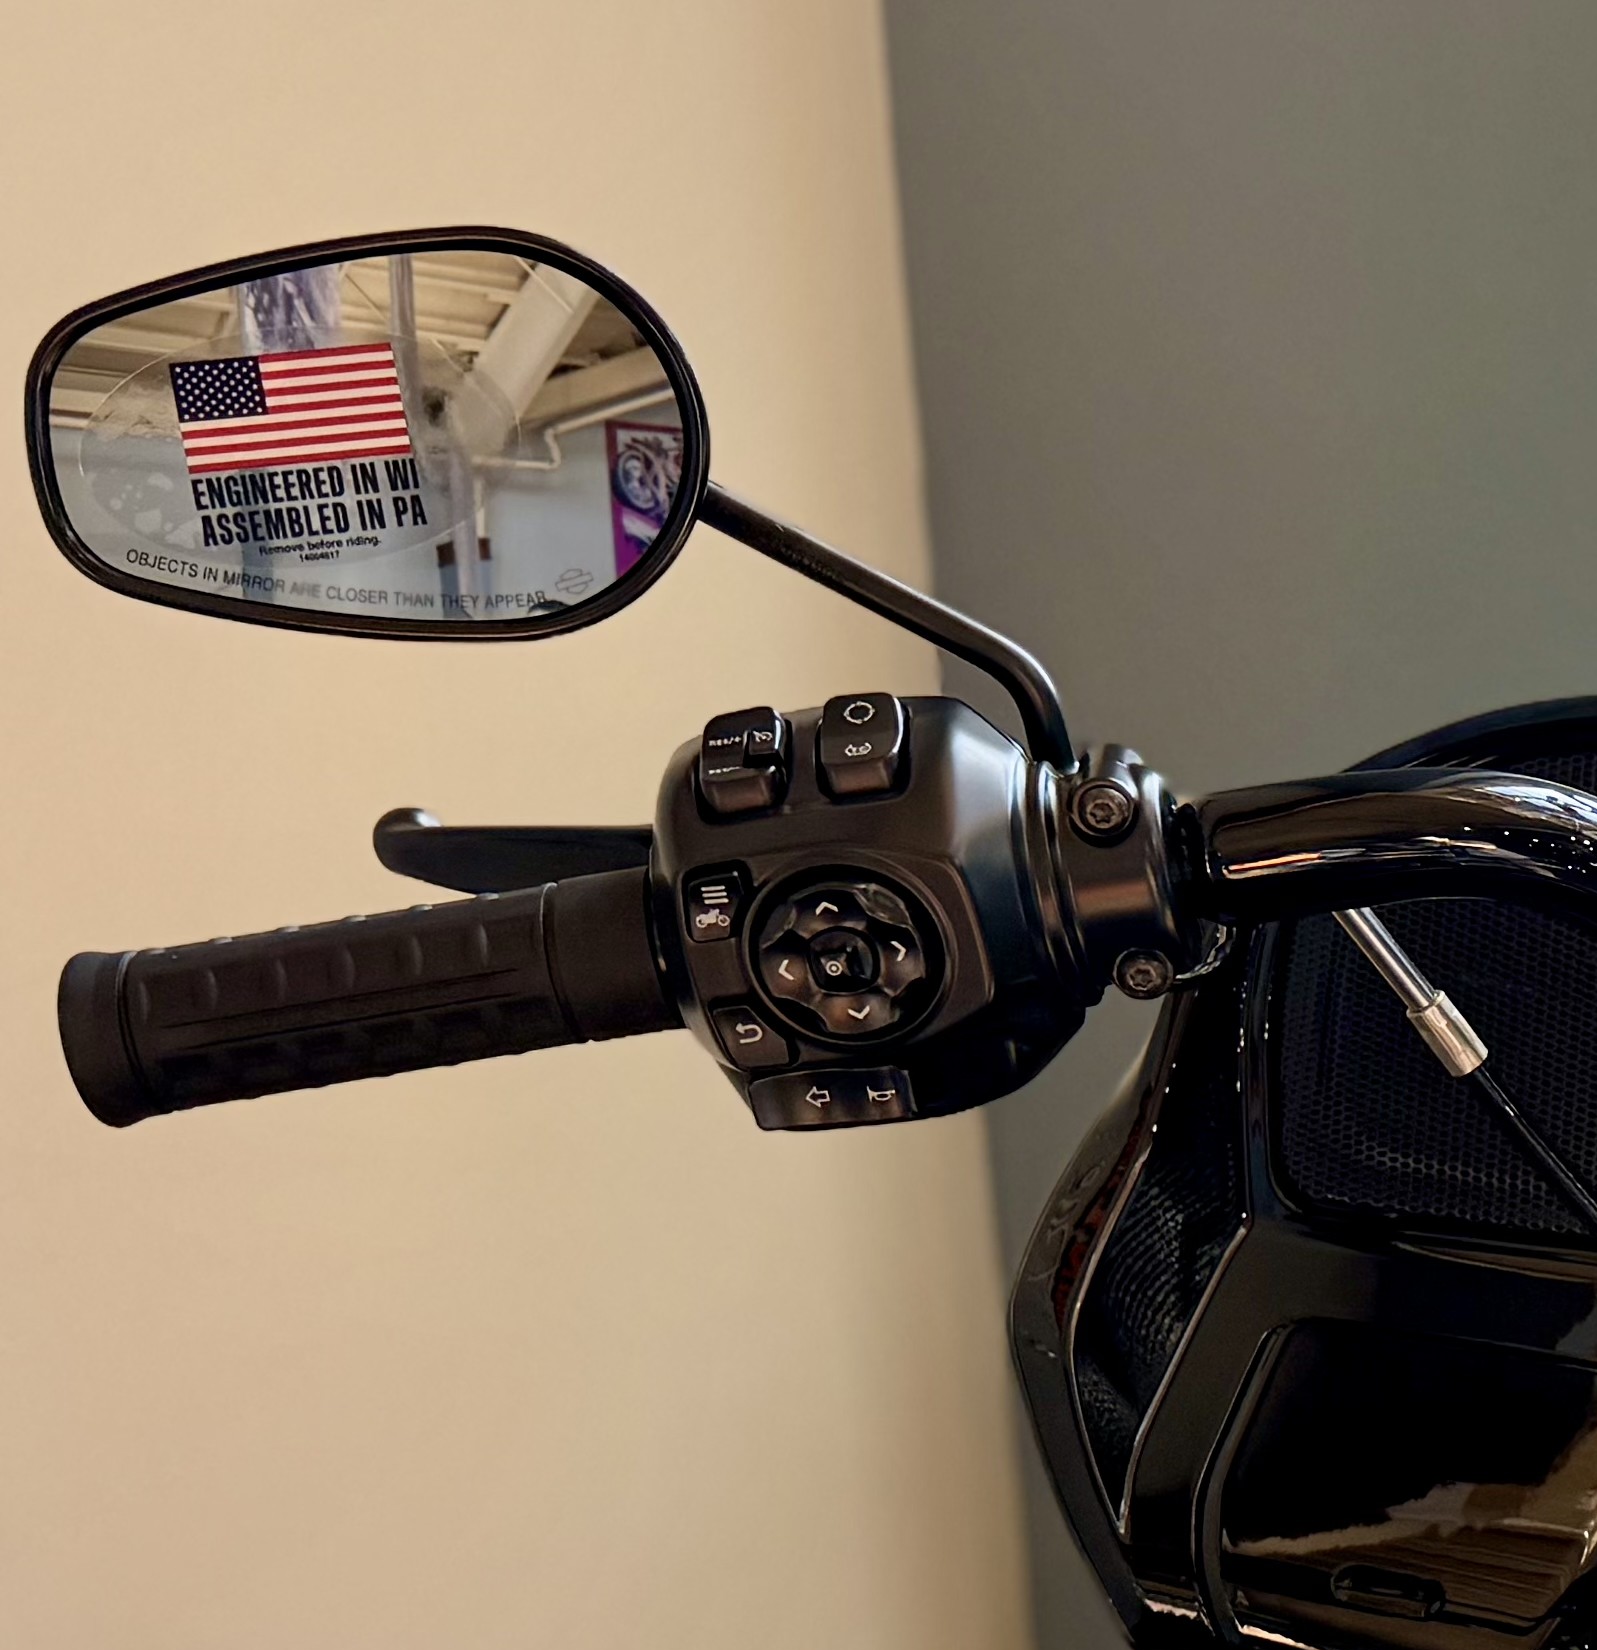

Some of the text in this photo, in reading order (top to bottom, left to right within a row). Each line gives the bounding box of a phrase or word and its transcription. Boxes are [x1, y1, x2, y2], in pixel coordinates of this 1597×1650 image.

[190, 458, 420, 511] ENGINEERED IN WI
[201, 494, 428, 547] ASSEMBLED IN PA
[259, 544, 305, 557] Remove
[307, 539, 344, 551] before
[126, 549, 547, 609] OBJECTS IN MIRROR ARE CLOSER THAN THEY APPEAR
